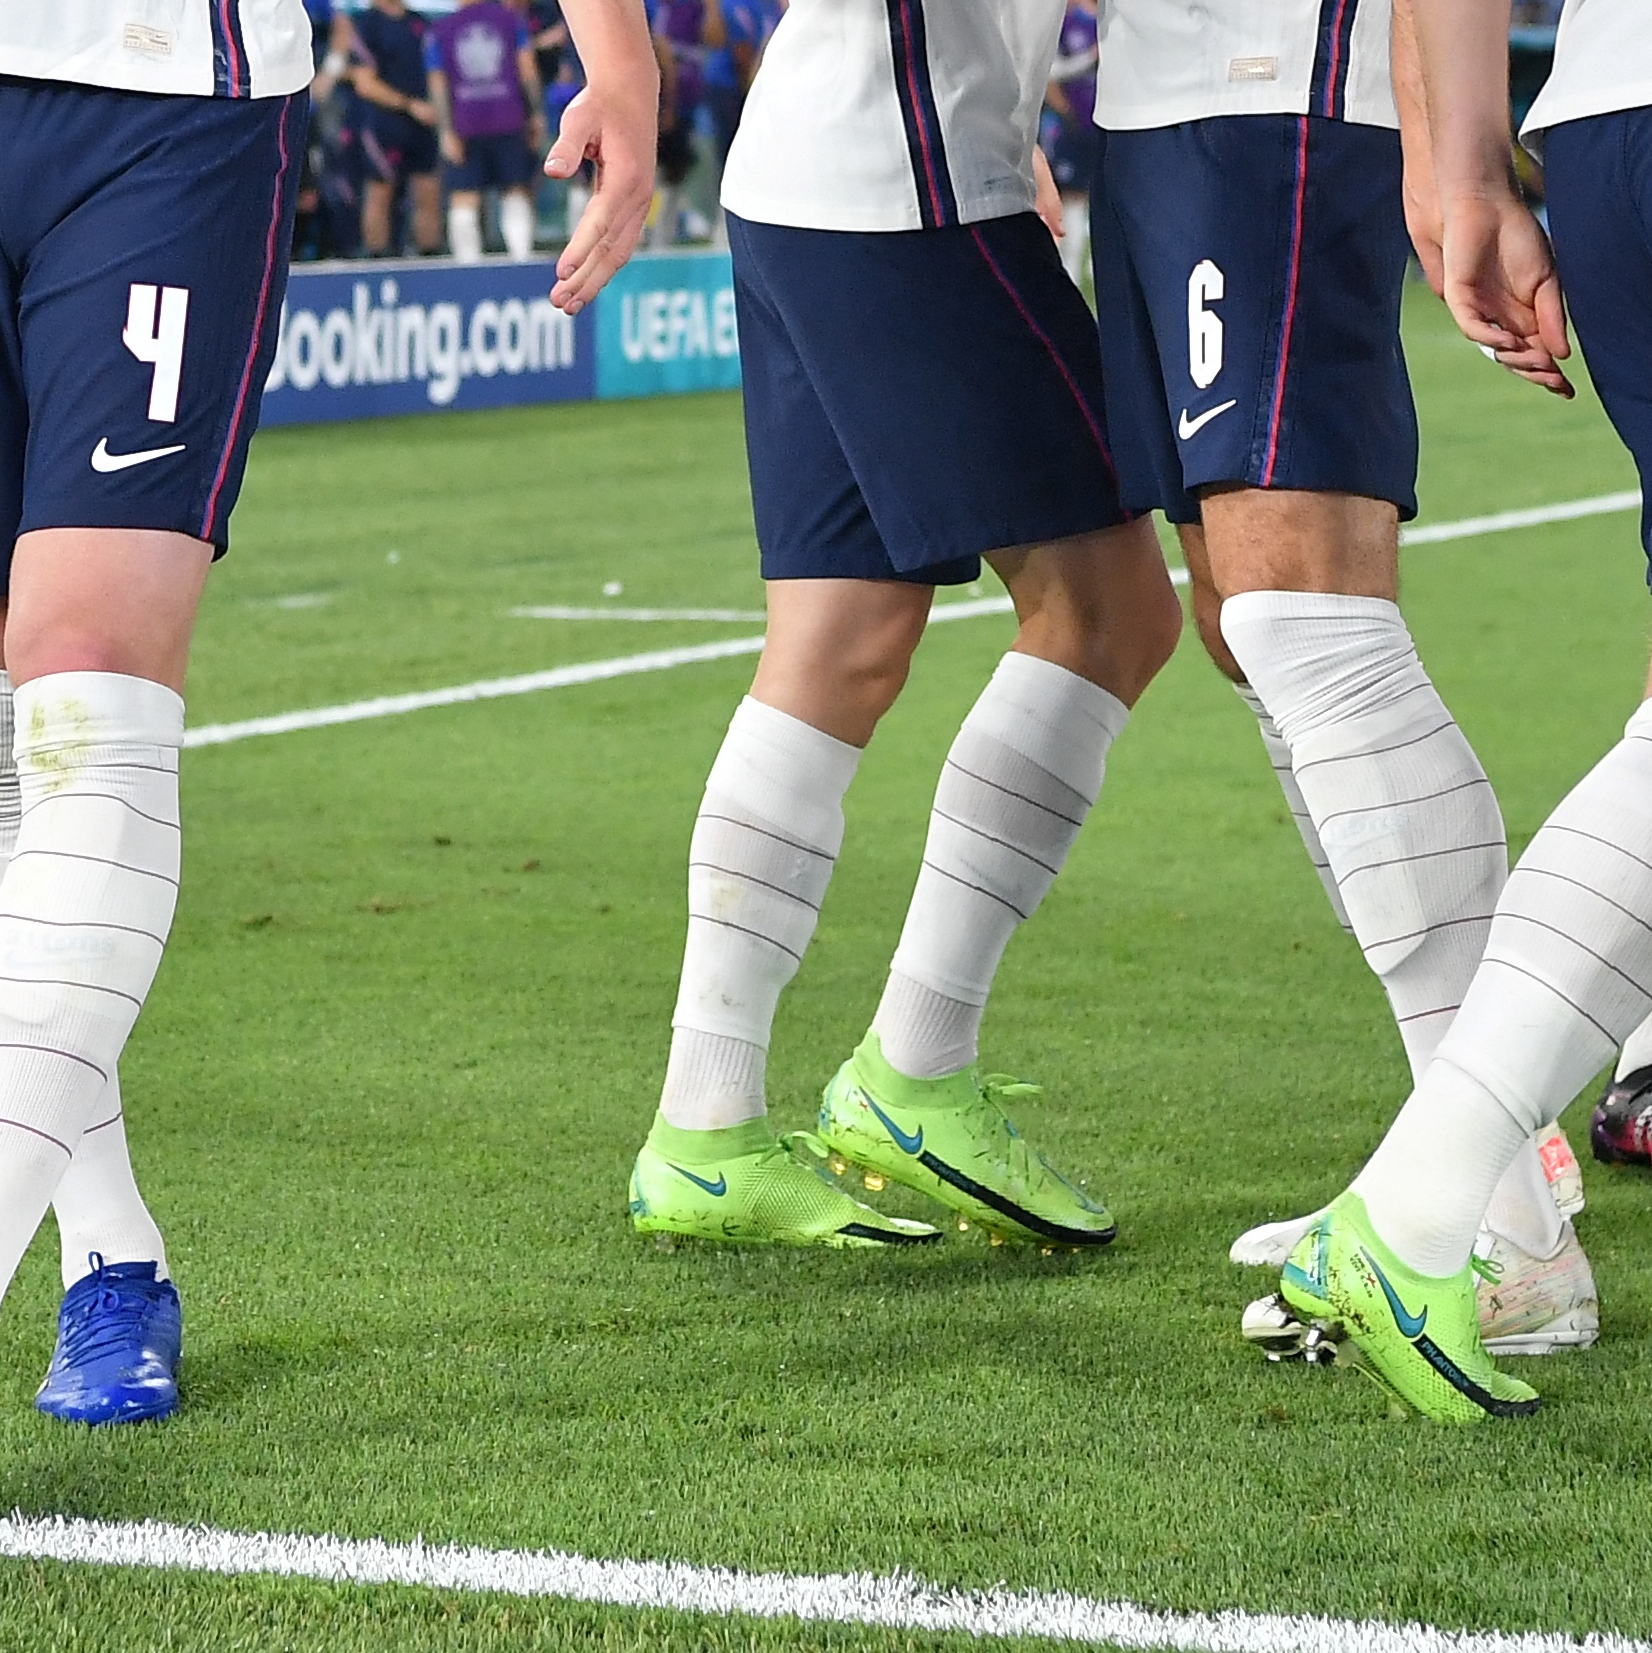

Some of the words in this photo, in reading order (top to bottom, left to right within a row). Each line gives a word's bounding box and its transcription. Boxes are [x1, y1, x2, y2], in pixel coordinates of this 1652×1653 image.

[122, 283, 189, 424] 4
[621, 289, 709, 362] UEFA
[1187, 259, 1225, 389] 6
